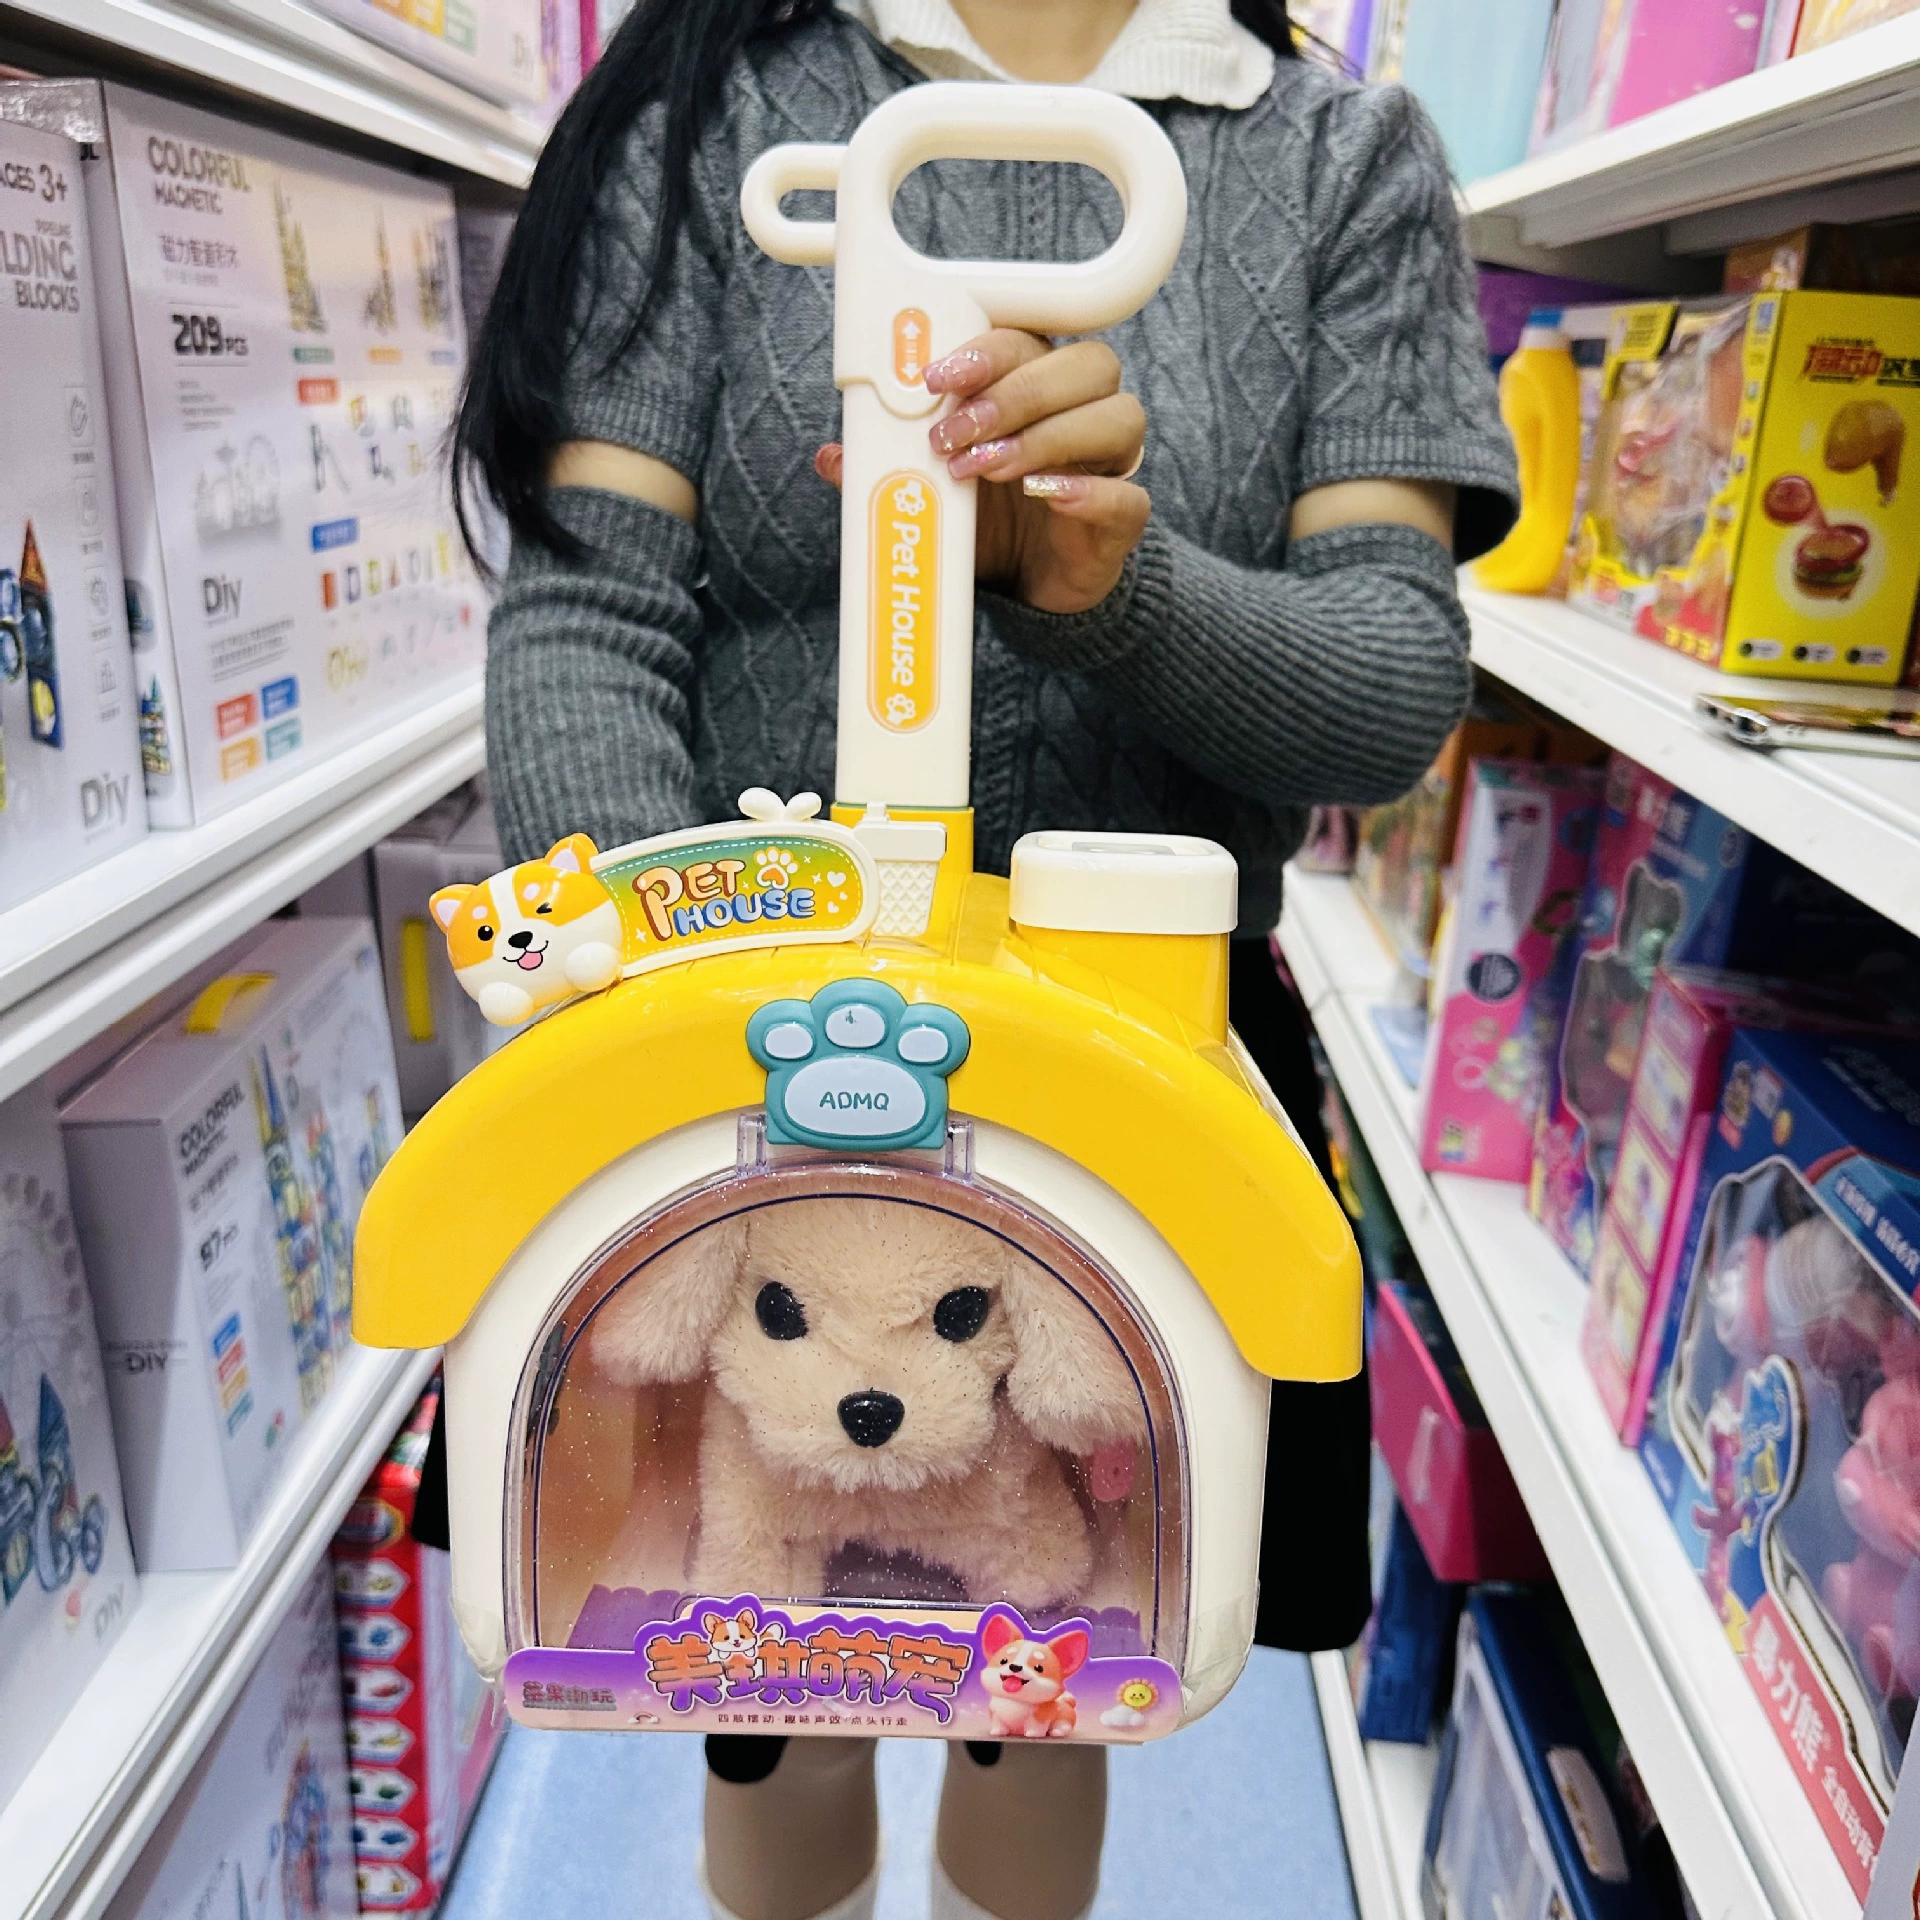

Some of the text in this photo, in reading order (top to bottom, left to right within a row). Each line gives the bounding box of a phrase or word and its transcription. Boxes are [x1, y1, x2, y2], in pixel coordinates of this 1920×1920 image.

[172, 314, 223, 356] 209
[891, 521, 921, 687] Pet House
[632, 859, 747, 942] PET
[673, 888, 816, 937] HOUSE
[819, 1091, 890, 1111] ADMQ
[126, 1352, 168, 1375] DIY
[646, 1627, 973, 1724] 美琪萌宠
